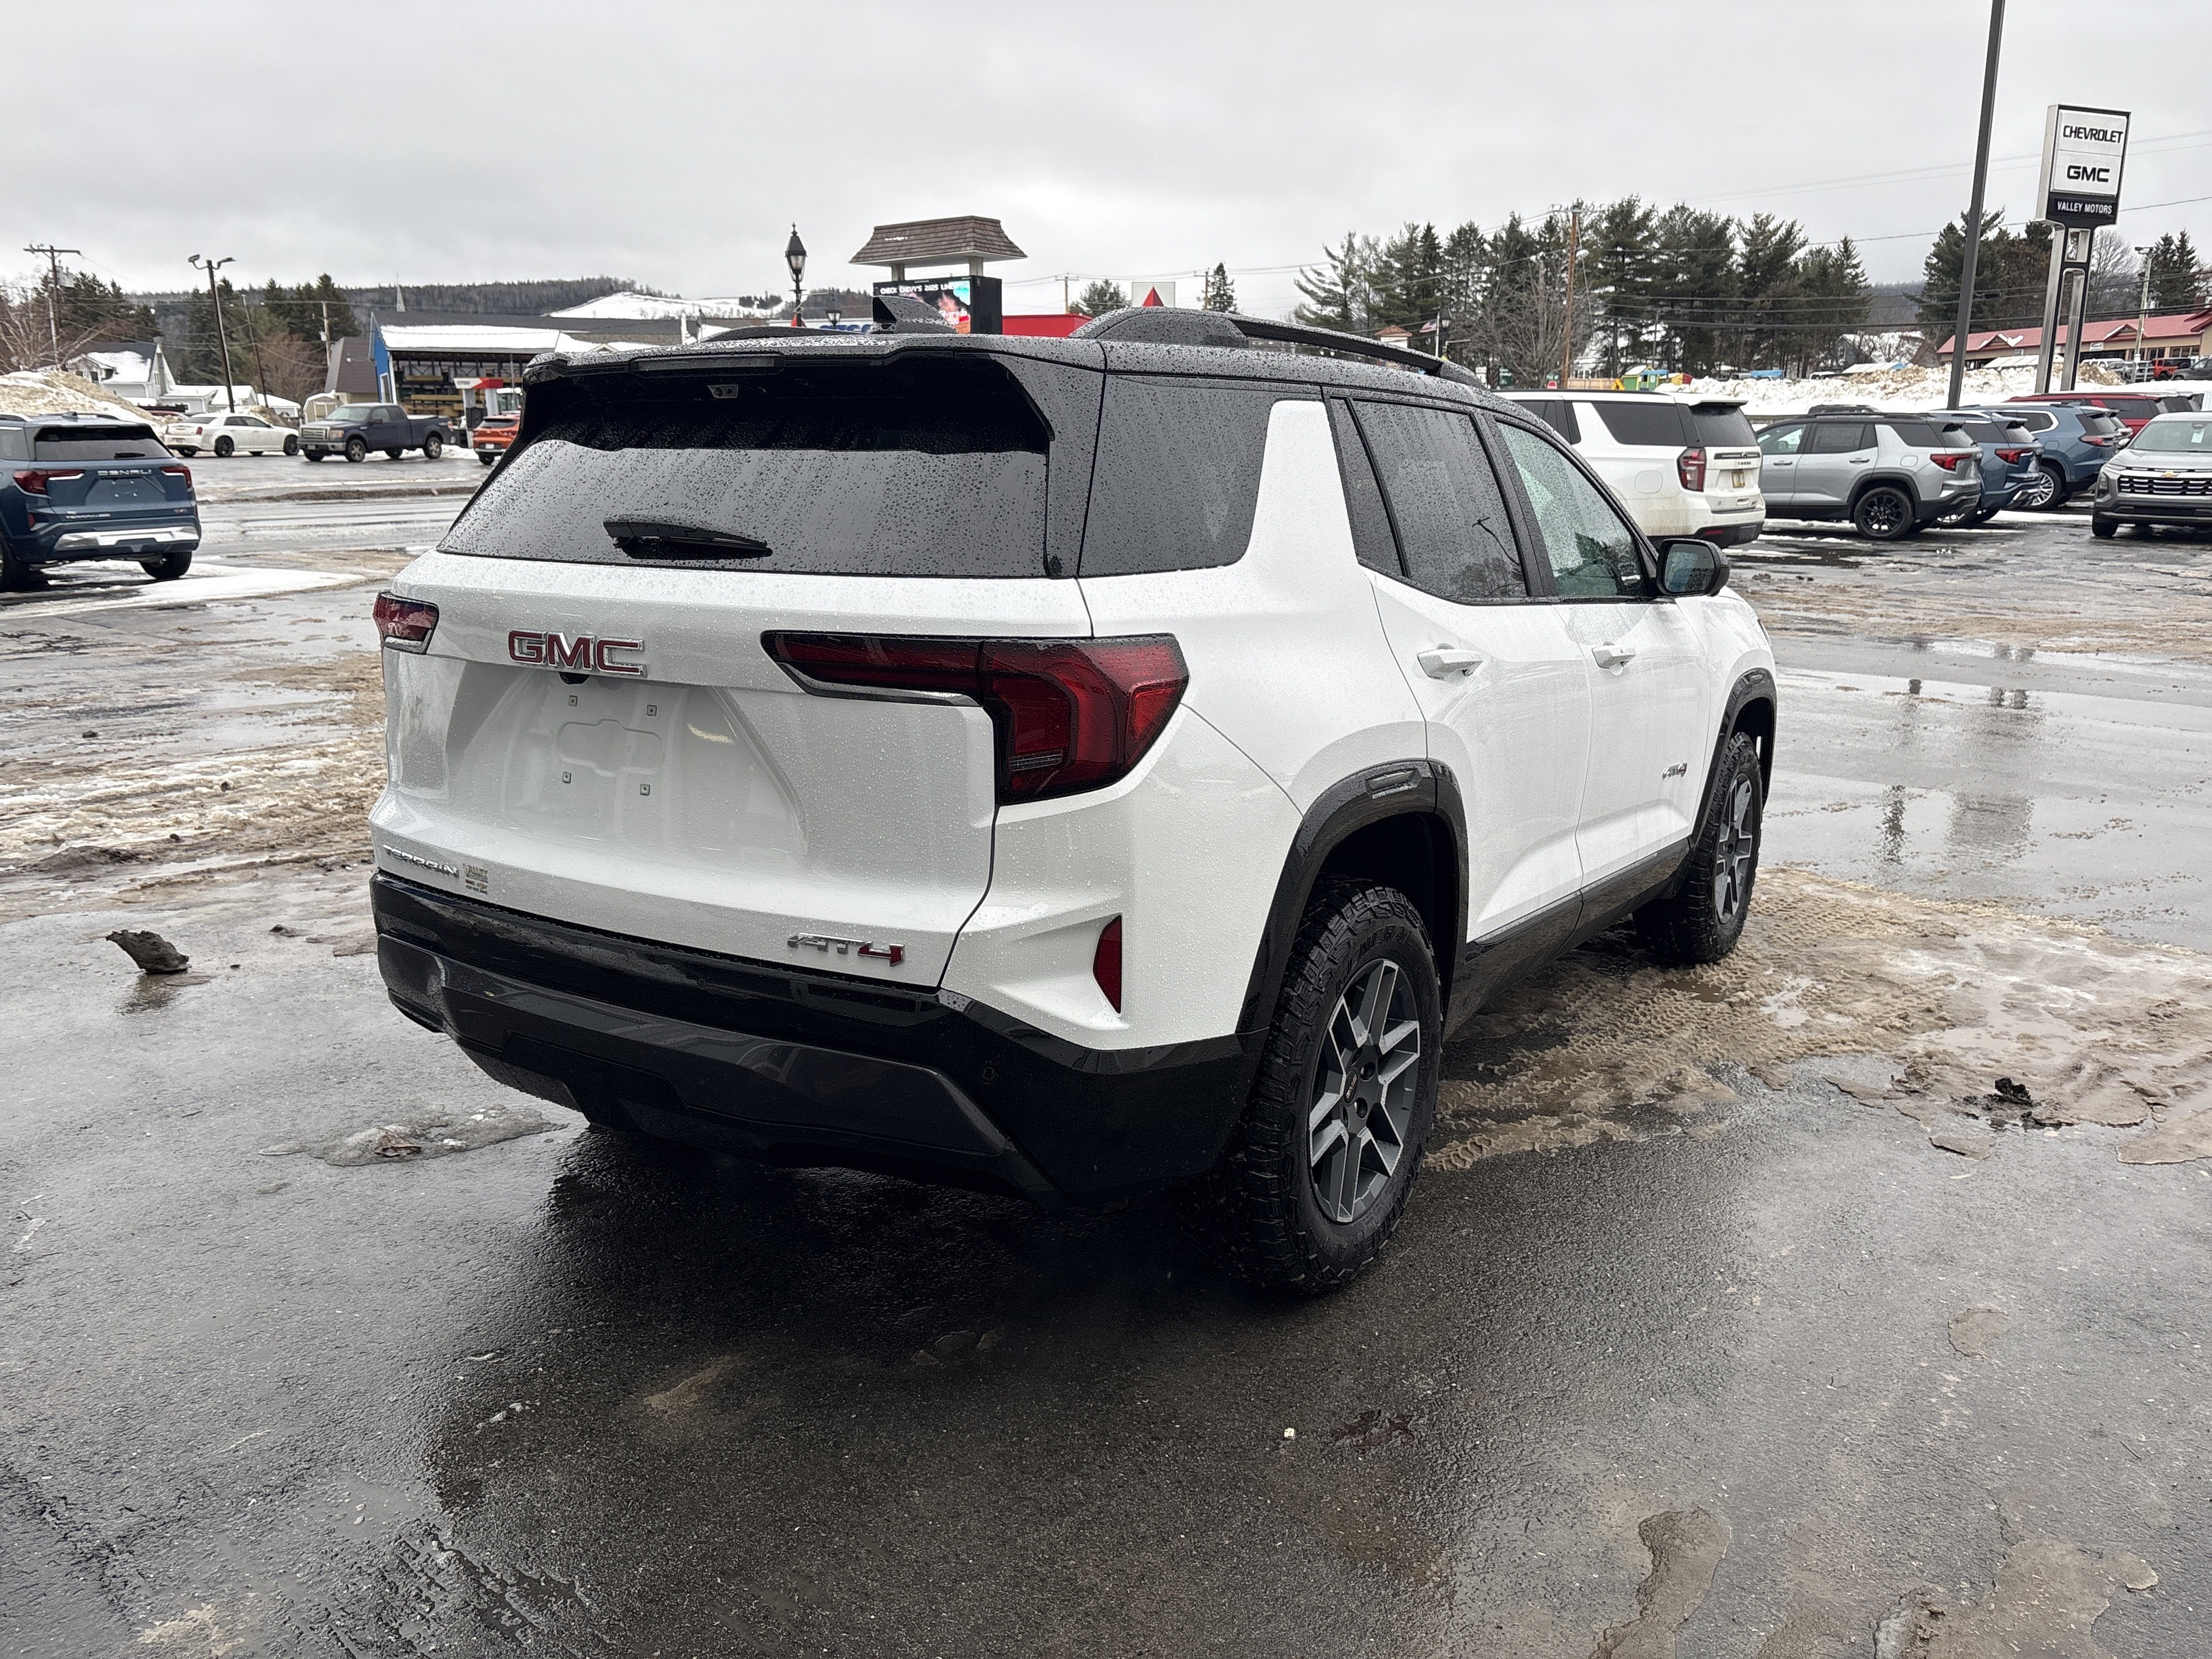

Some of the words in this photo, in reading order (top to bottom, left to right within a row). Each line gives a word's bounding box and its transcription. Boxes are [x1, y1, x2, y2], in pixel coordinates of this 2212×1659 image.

[2063, 125, 2124, 144] CHEVROLET
[2067, 165, 2110, 183] GMC
[2057, 201, 2083, 212] VALLEY
[2085, 203, 2112, 214] MOTORS
[508, 628, 647, 678] GMC
[382, 844, 459, 879] TERRAIN
[787, 932, 905, 967] AT4
